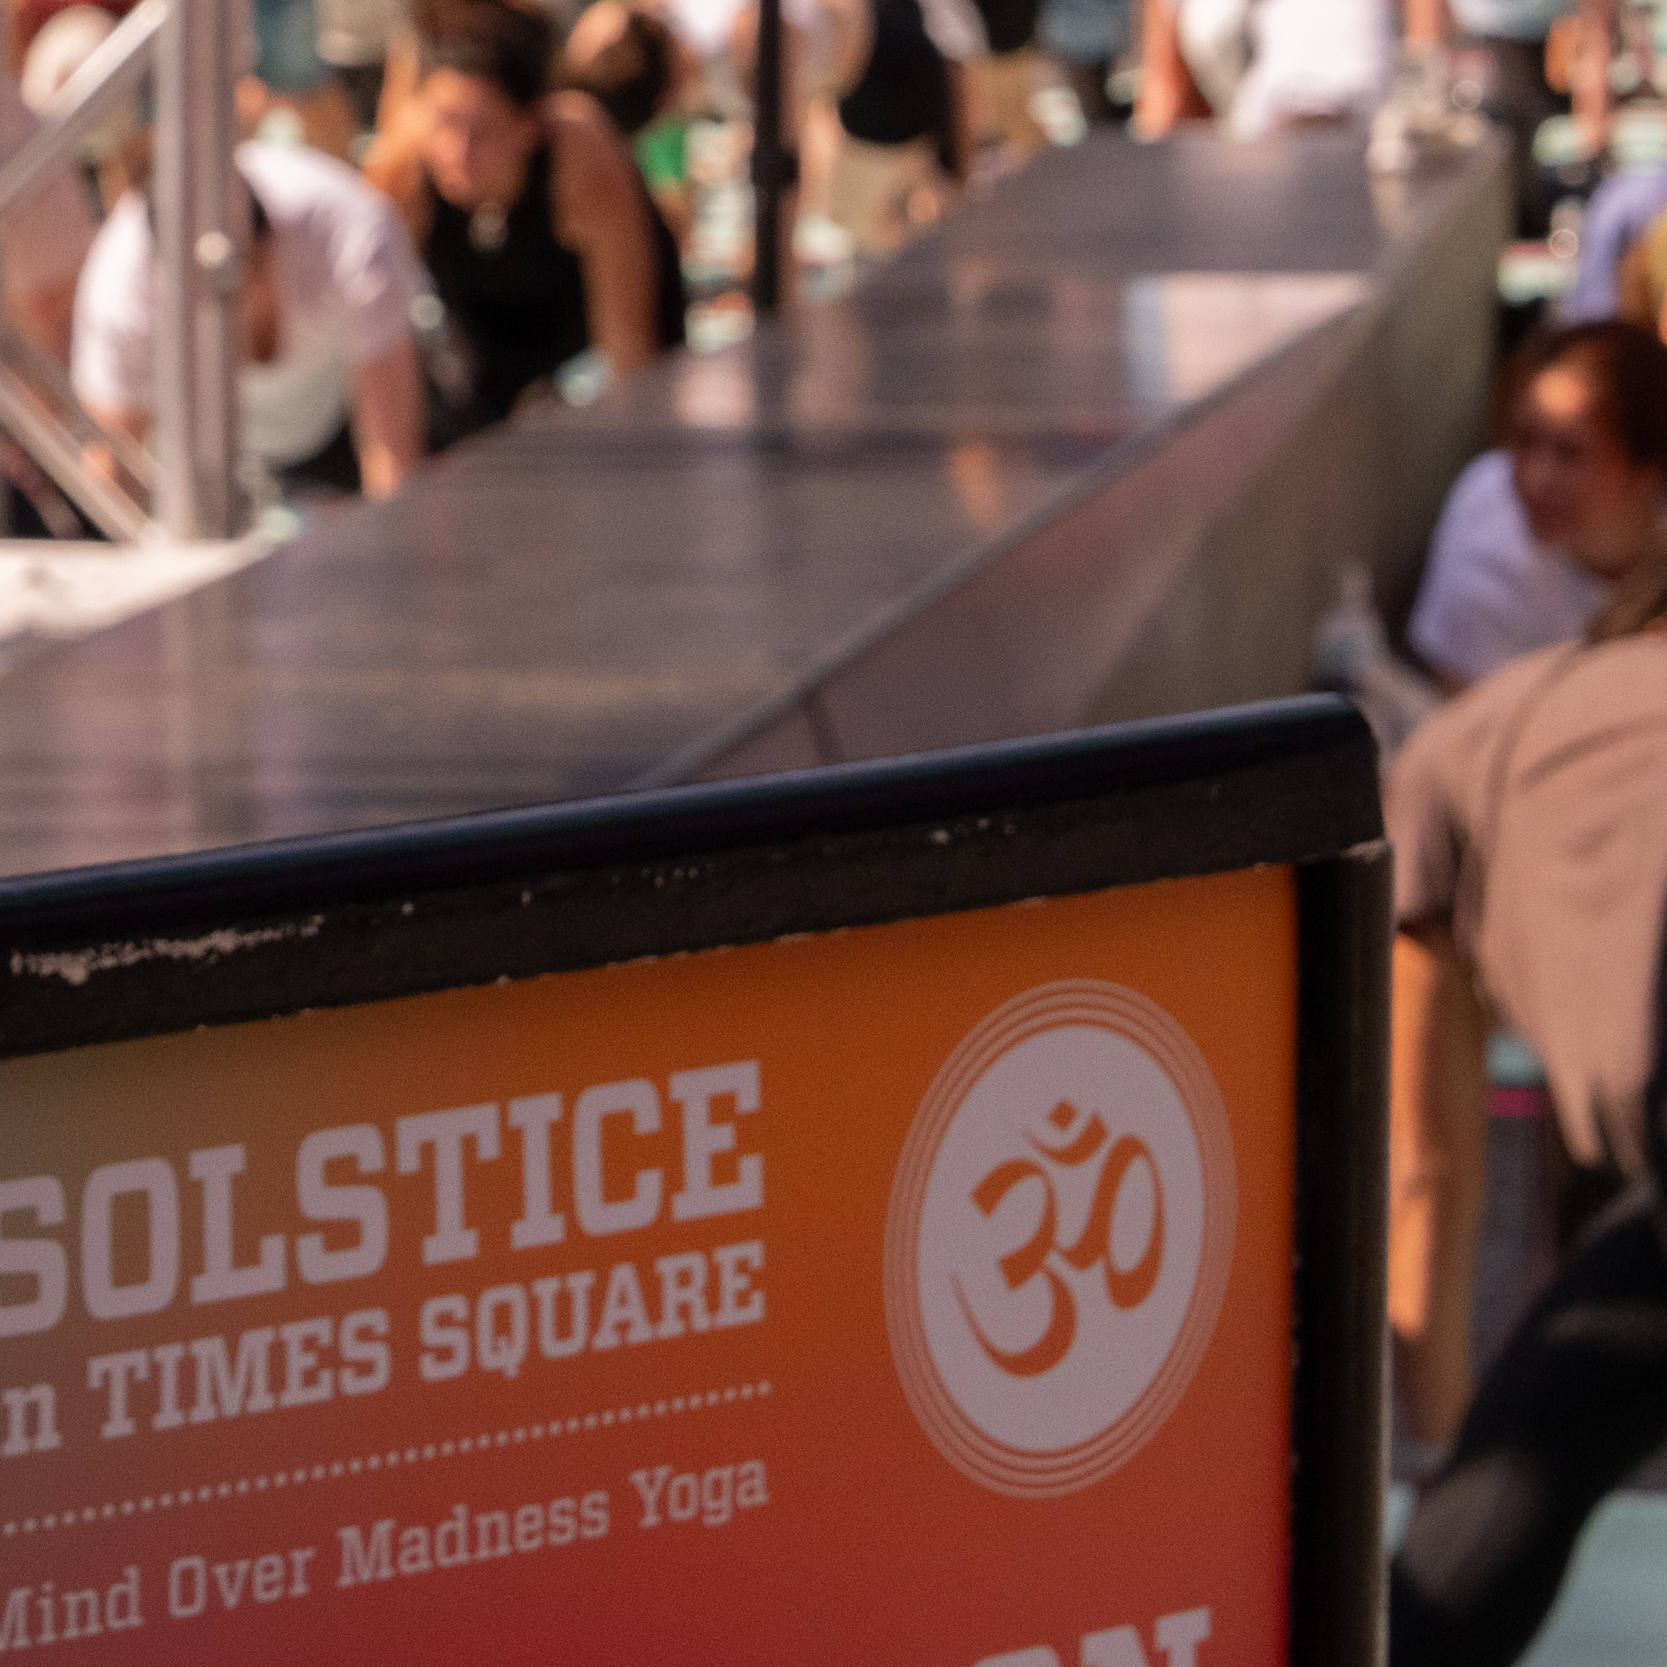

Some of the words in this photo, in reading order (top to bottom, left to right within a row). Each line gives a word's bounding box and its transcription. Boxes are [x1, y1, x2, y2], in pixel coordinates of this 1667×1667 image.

[86, 1308, 392, 1441] TIMES
[418, 1240, 766, 1384] SQUARE
[168, 1547, 317, 1619] Over
[337, 1488, 610, 1589] Madness
[629, 1459, 770, 1530] Yoga
